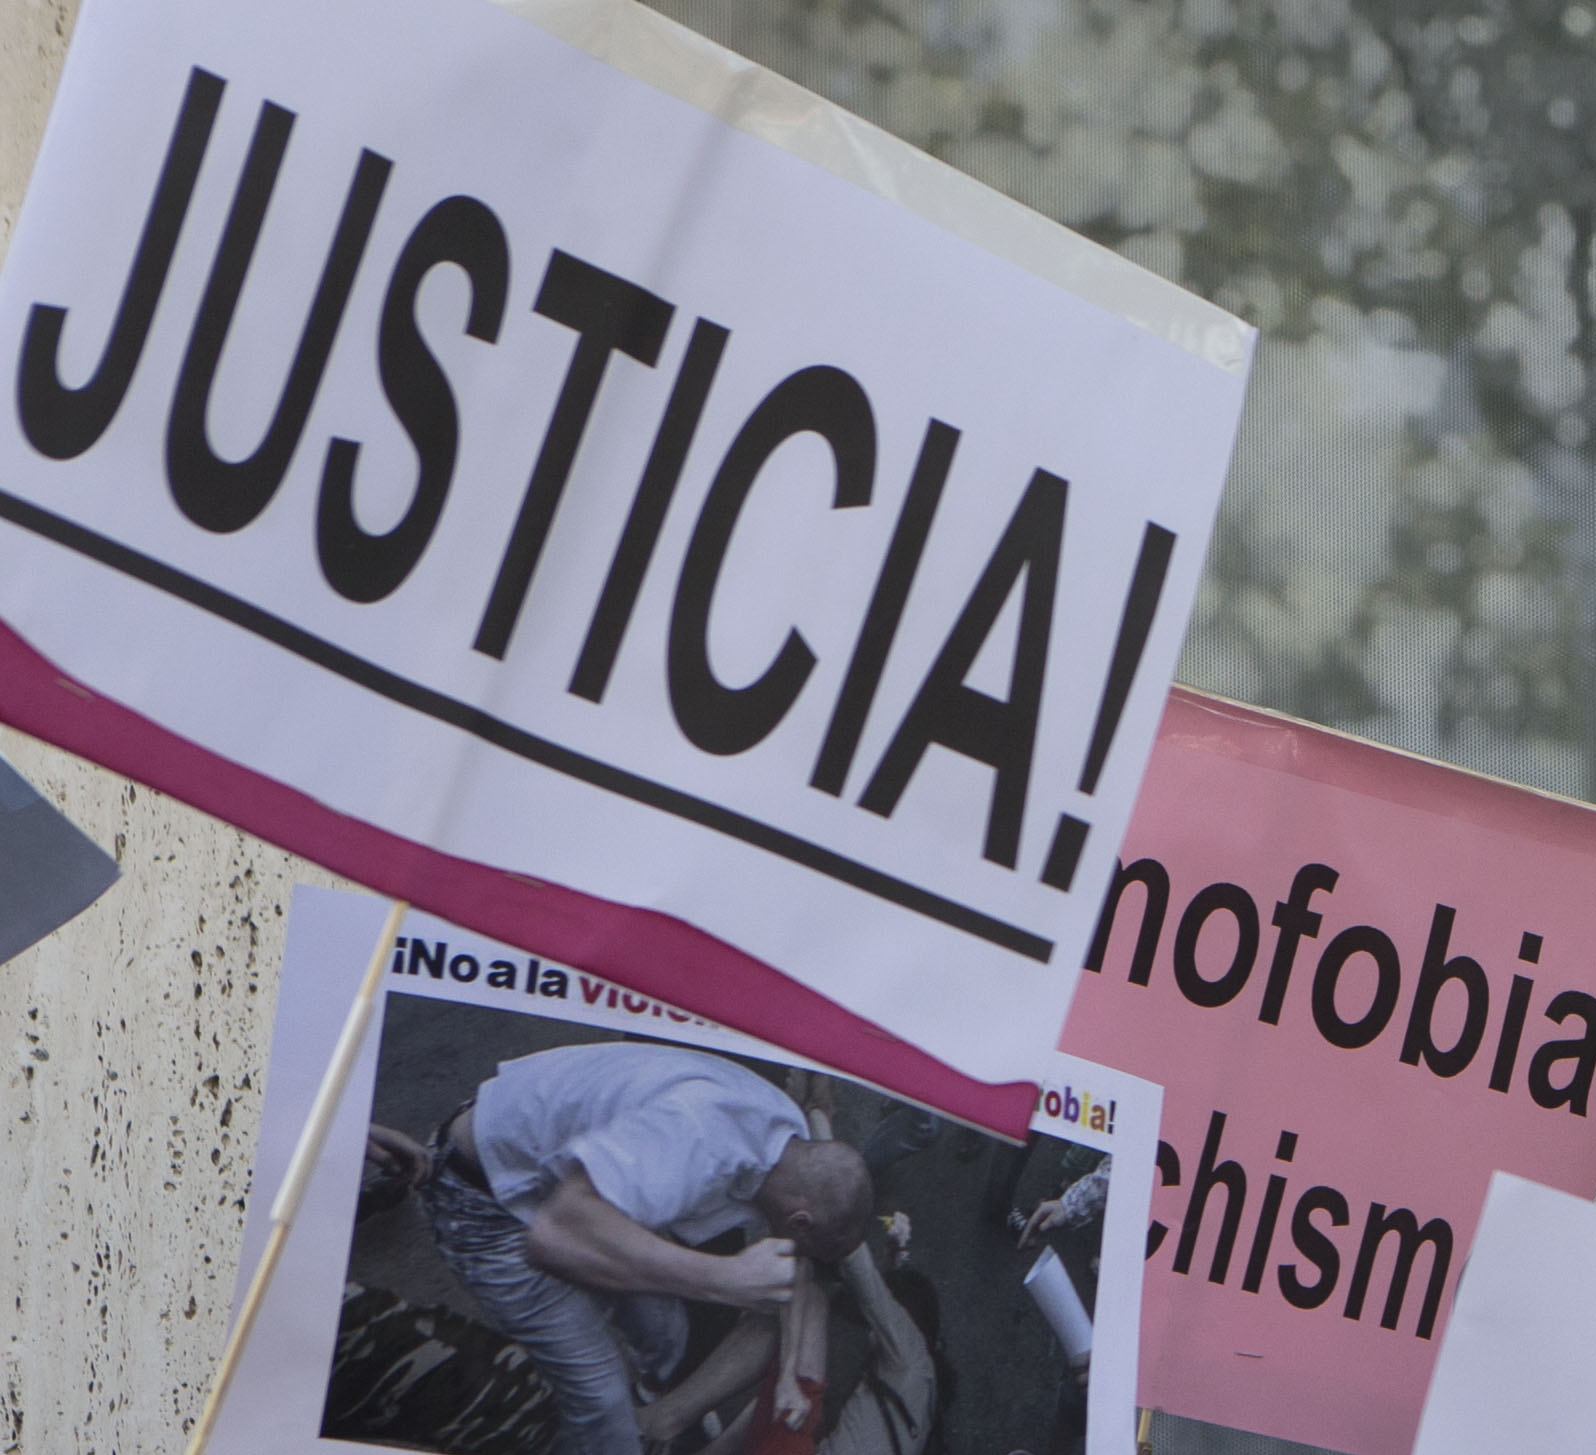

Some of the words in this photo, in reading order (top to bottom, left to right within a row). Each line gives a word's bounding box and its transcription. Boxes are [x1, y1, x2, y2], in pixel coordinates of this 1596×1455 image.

[16, 64, 1179, 894] JUSTICIA!
[486, 959, 518, 990] a
[525, 959, 569, 1000] la
